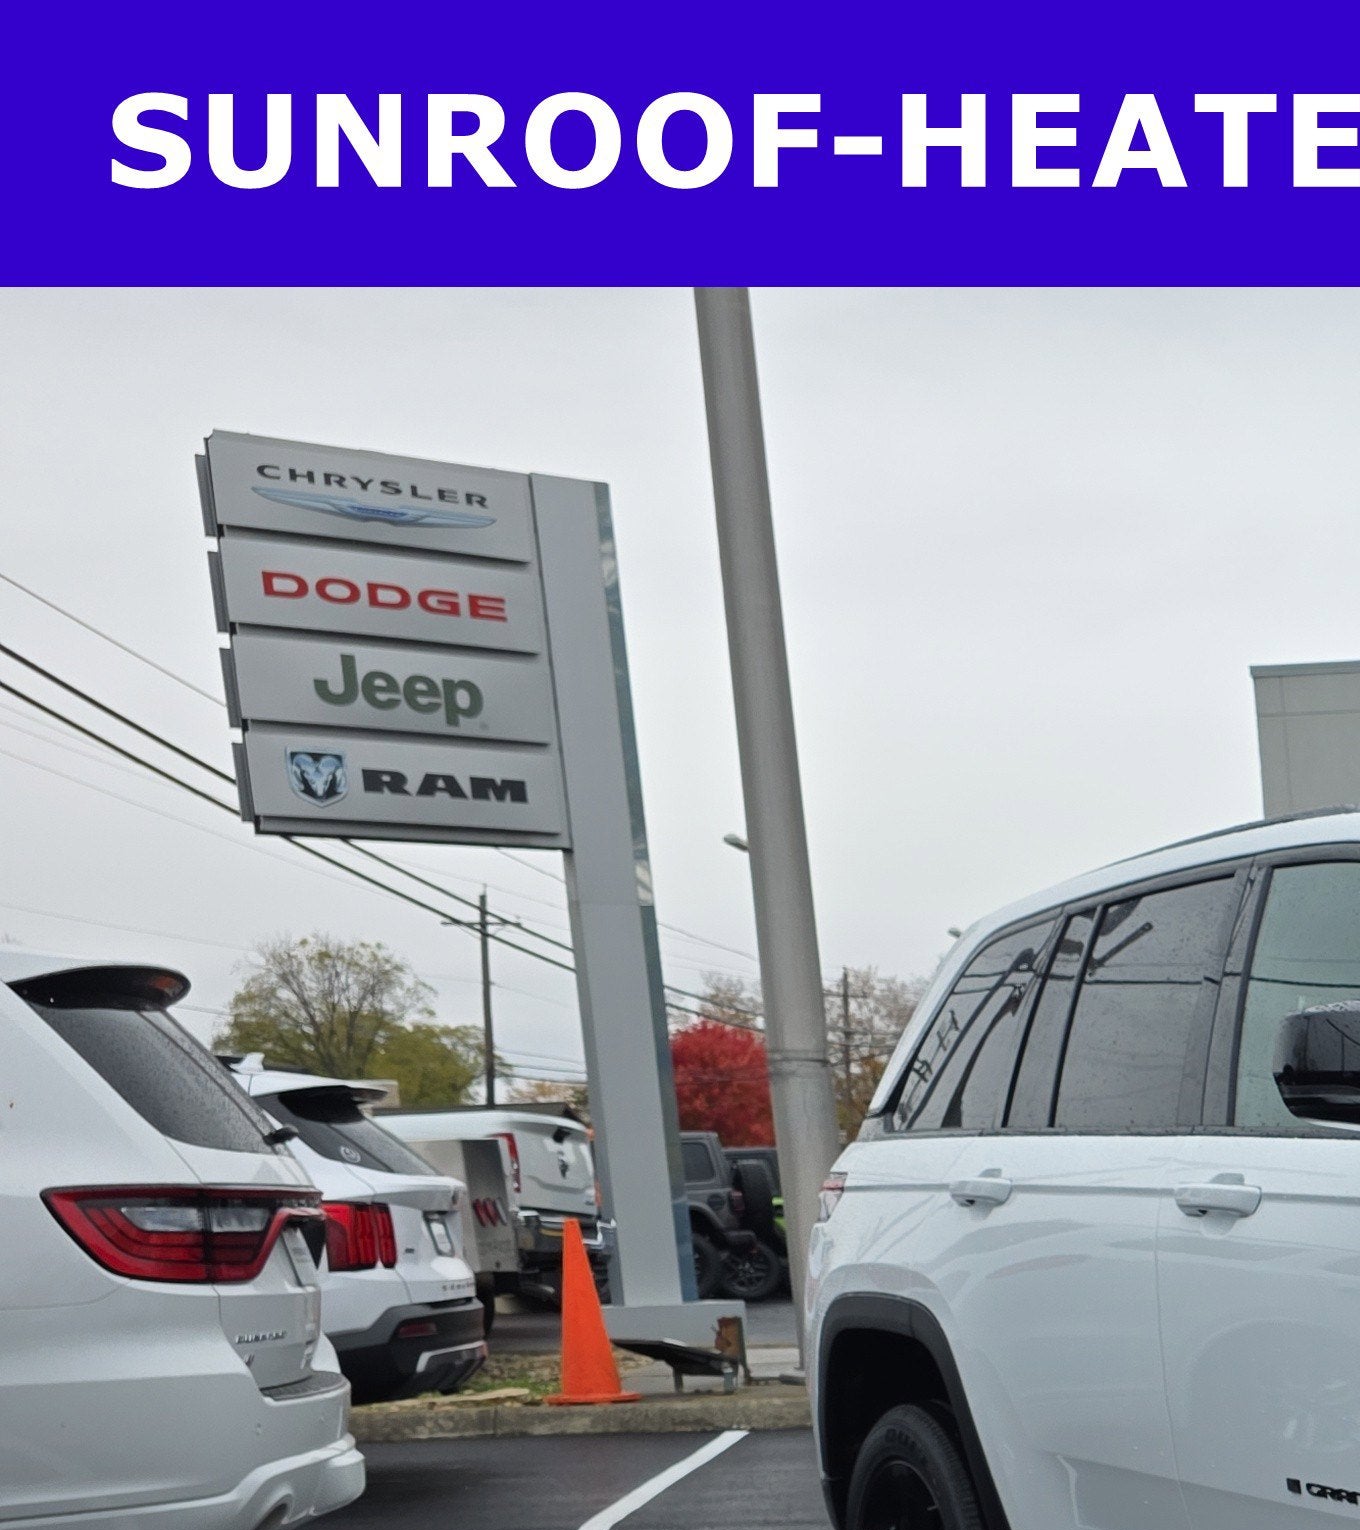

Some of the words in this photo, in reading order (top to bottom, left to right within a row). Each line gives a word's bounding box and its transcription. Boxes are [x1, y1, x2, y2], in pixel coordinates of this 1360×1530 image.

[256, 464, 489, 509] CHRYSLER
[261, 570, 508, 623] DODGE
[313, 653, 484, 728] Jeep
[361, 768, 529, 804] RAM
